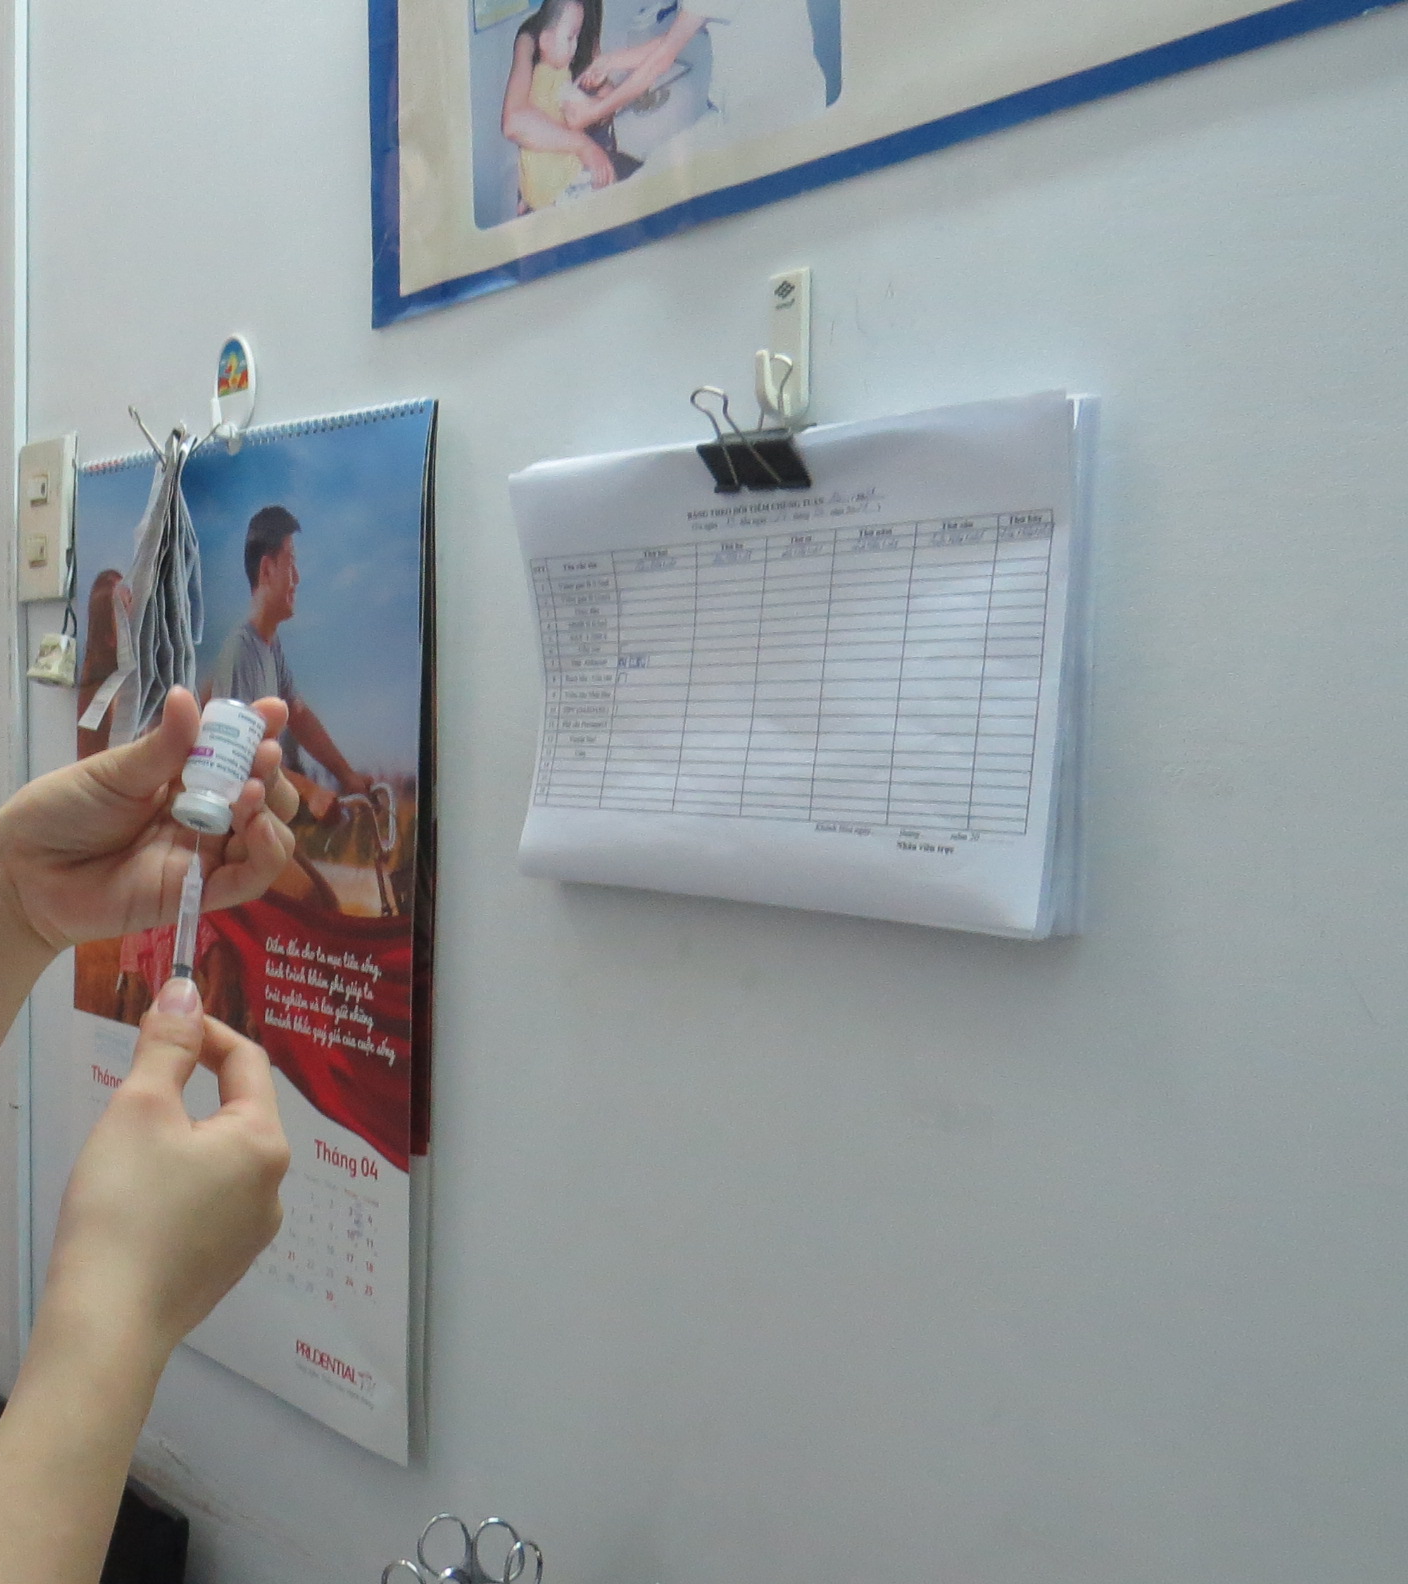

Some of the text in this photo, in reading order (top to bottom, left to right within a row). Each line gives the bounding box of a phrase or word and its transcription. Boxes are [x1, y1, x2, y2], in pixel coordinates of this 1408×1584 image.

[314, 1139, 379, 1181] Tháng 04
[295, 1338, 357, 1386] PRUDENTIAL
